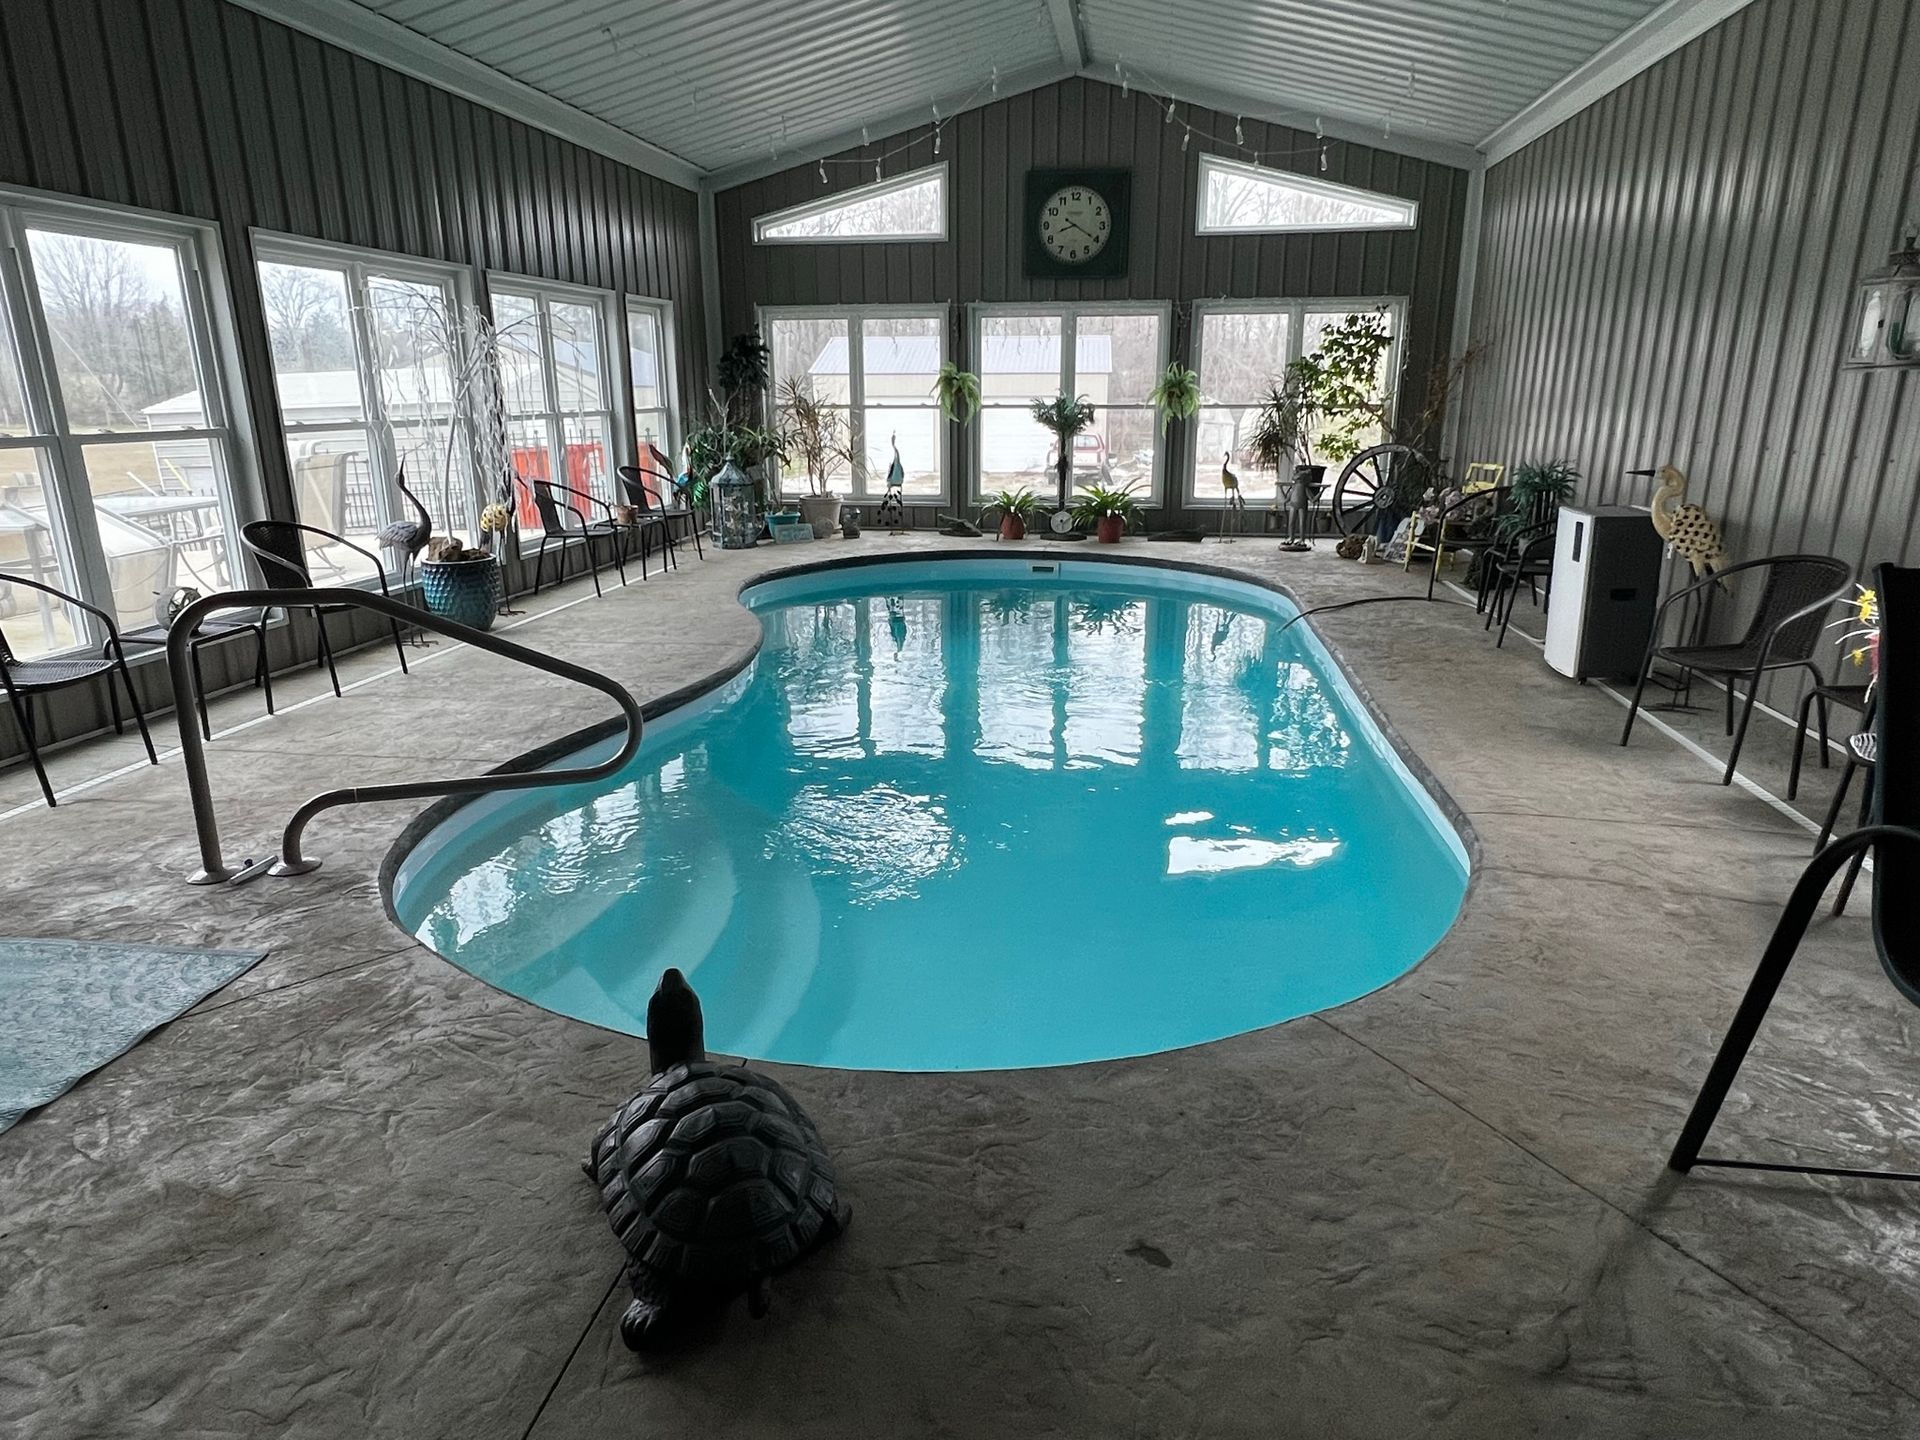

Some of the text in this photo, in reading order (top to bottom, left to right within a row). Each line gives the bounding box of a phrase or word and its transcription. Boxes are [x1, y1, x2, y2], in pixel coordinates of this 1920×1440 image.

[1059, 197, 1067, 205] 11
[1071, 192, 1082, 201] 12
[1088, 197, 1092, 205] 1
[1048, 207, 1059, 216] 10
[1096, 206, 1102, 216] 2
[1043, 221, 1050, 230] 9
[1099, 221, 1106, 230] 3
[1047, 235, 1054, 244] 8
[1093, 235, 1100, 243] 4
[1058, 245, 1064, 254] 7
[1083, 245, 1090, 254] 5
[1070, 250, 1077, 259] 6
